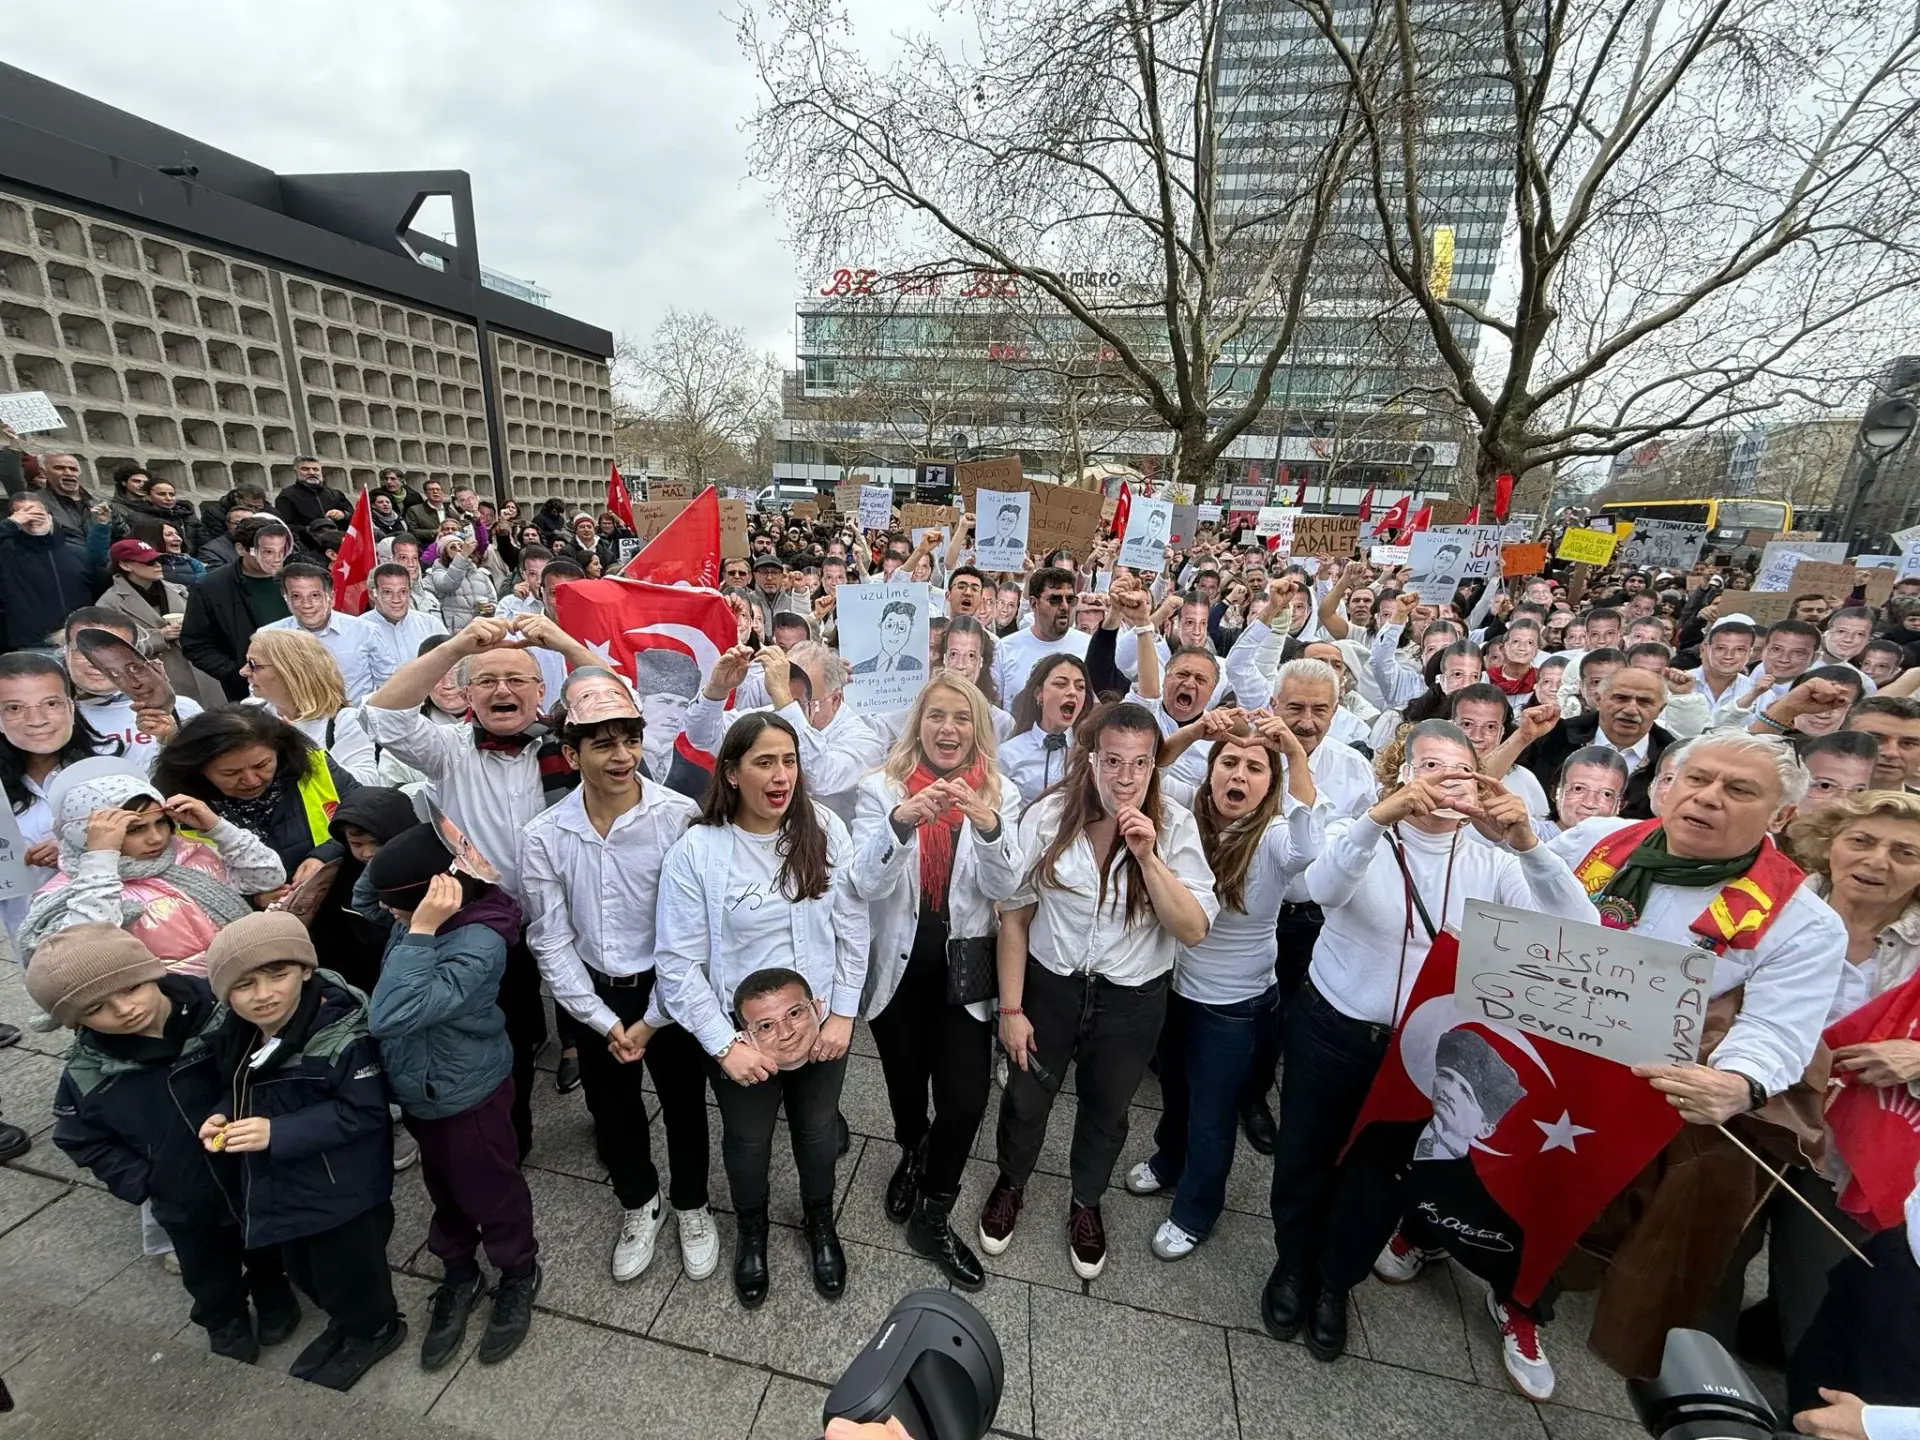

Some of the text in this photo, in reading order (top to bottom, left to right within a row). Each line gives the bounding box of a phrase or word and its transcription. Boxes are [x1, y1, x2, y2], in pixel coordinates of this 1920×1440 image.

[960, 465, 1010, 484] Diploma
[1292, 517, 1318, 533] HAK
[1321, 517, 1359, 533] HUKUK
[1294, 535, 1357, 553] ADALET
[875, 687, 903, 695] olacak
[1508, 963, 1629, 1002] Selam
[1664, 952, 1709, 1068] ÇARŞ
[1475, 996, 1603, 1047] Devam
